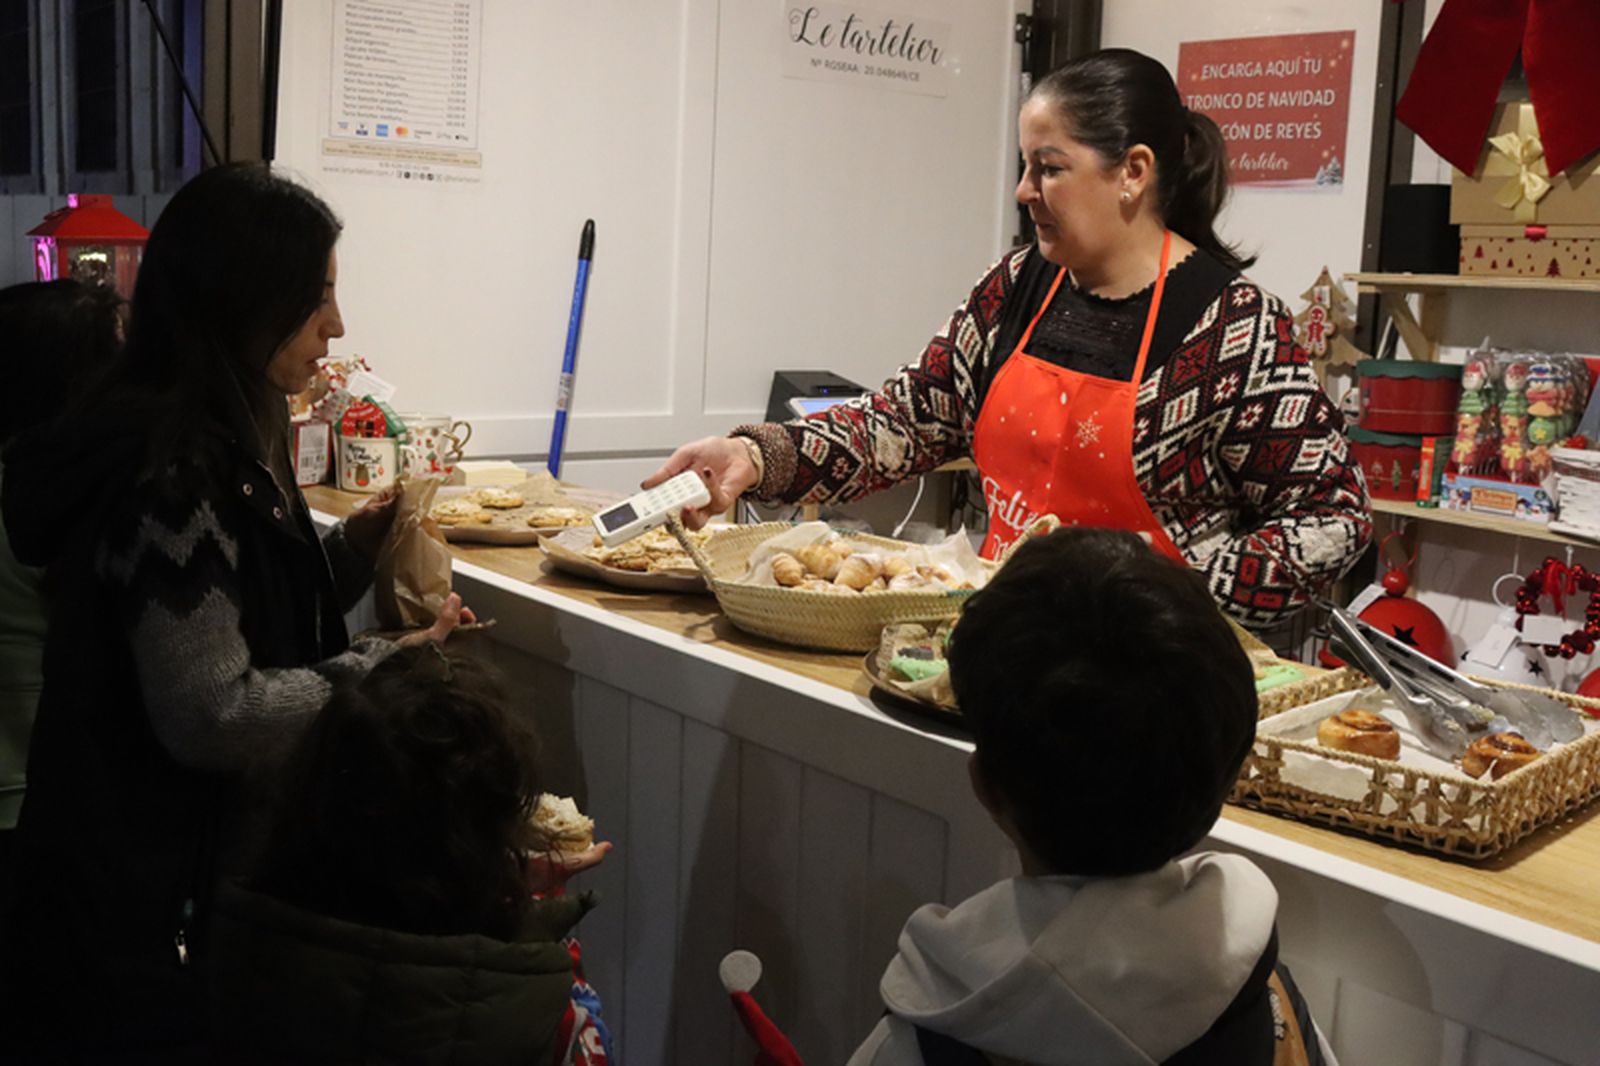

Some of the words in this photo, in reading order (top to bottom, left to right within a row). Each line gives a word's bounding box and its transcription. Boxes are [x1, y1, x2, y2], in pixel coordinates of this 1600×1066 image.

[789, 7, 836, 48] Le
[840, 13, 944, 65] tartelier
[1201, 61, 1263, 80] ENCARGA
[1265, 56, 1301, 77] AQUÍ
[1303, 58, 1322, 75] TU
[1186, 93, 1243, 111] TRONCO
[1245, 92, 1265, 109] DE
[1268, 89, 1336, 107] NAVIDAD
[1254, 123, 1273, 140] DE
[1276, 122, 1322, 139] REYES
